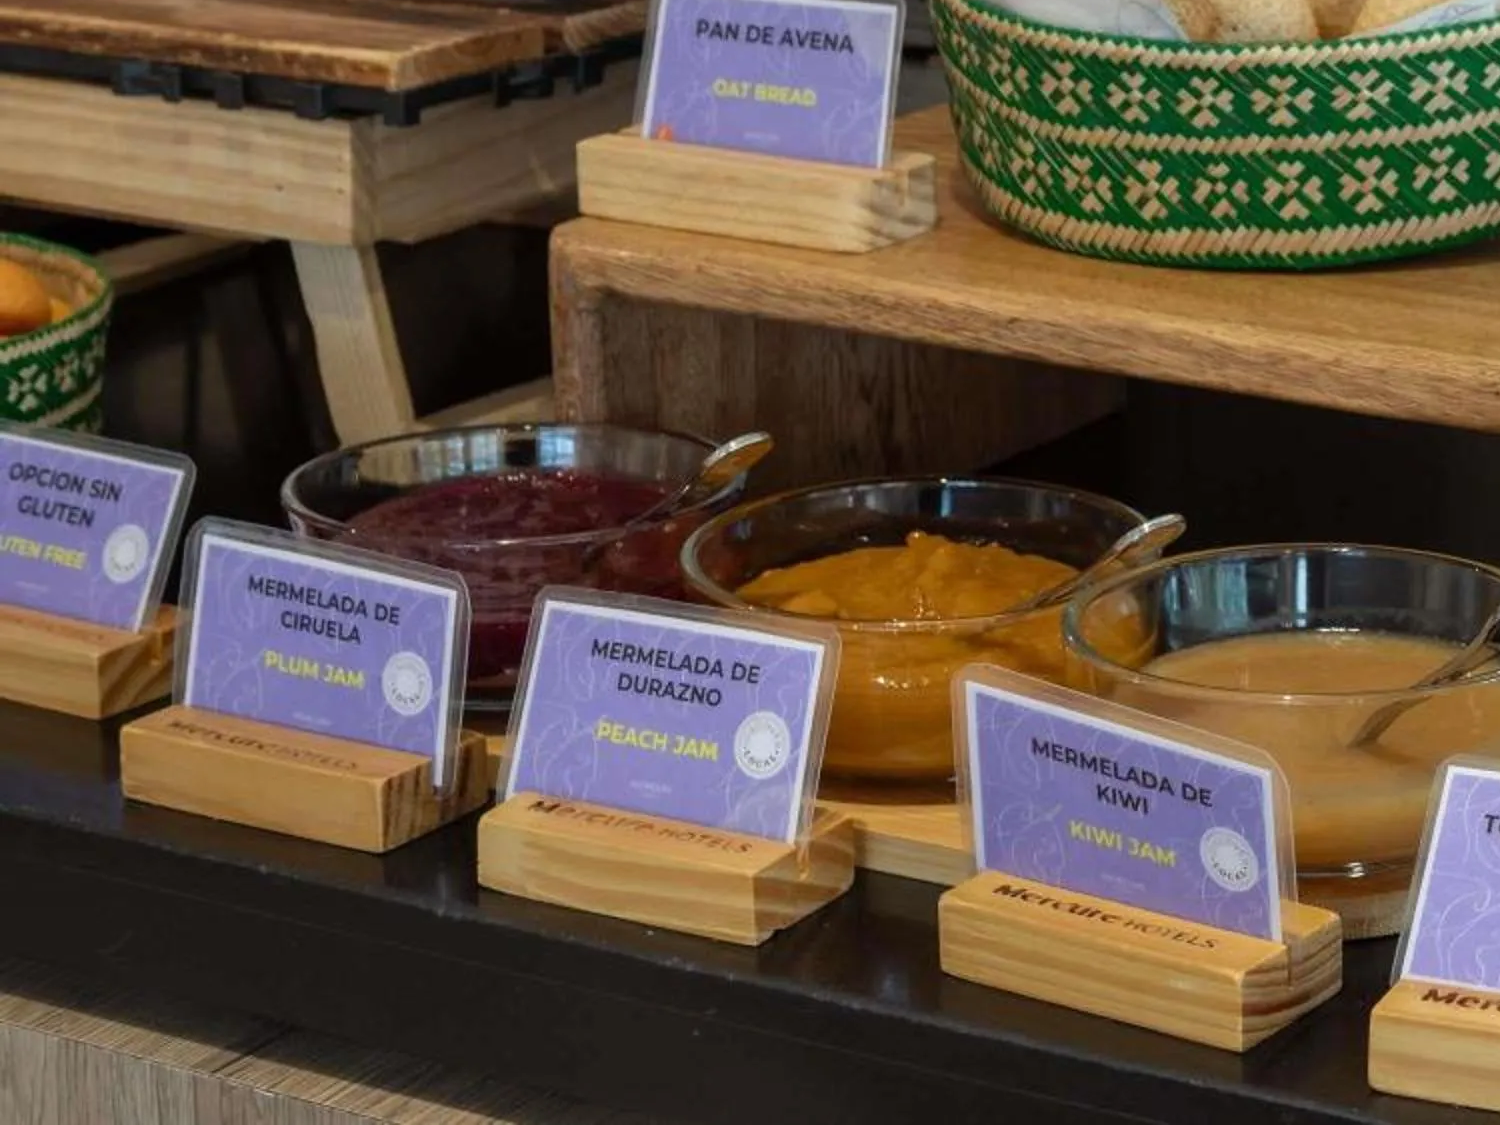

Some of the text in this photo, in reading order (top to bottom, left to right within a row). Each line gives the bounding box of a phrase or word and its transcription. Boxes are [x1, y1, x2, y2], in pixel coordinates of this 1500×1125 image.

[695, 19, 855, 53] PAN DE AVENA
[712, 78, 817, 107] OAT BREAD
[8, 462, 123, 503] OPCION SIN
[17, 495, 96, 528] GLUTEN
[0, 535, 41, 558] UTEN
[42, 546, 88, 571] FREE
[247, 575, 401, 626] MERMELADA DE
[280, 610, 362, 645] CIRUELA
[263, 649, 319, 679] PLUM
[323, 664, 366, 691] JAM
[590, 638, 762, 684] MERMELADA DE
[617, 674, 723, 708] DURAZNO
[597, 719, 670, 753] PEACH
[672, 736, 720, 762] JAM
[1031, 737, 1213, 808] MERMELADA DE
[527, 800, 656, 835] Mercure
[1096, 784, 1150, 816] KIWI
[1069, 821, 1122, 851] KIWI
[1127, 840, 1178, 868] JAM
[991, 883, 1120, 925] Mercure
[1122, 917, 1219, 949] HOTELS
